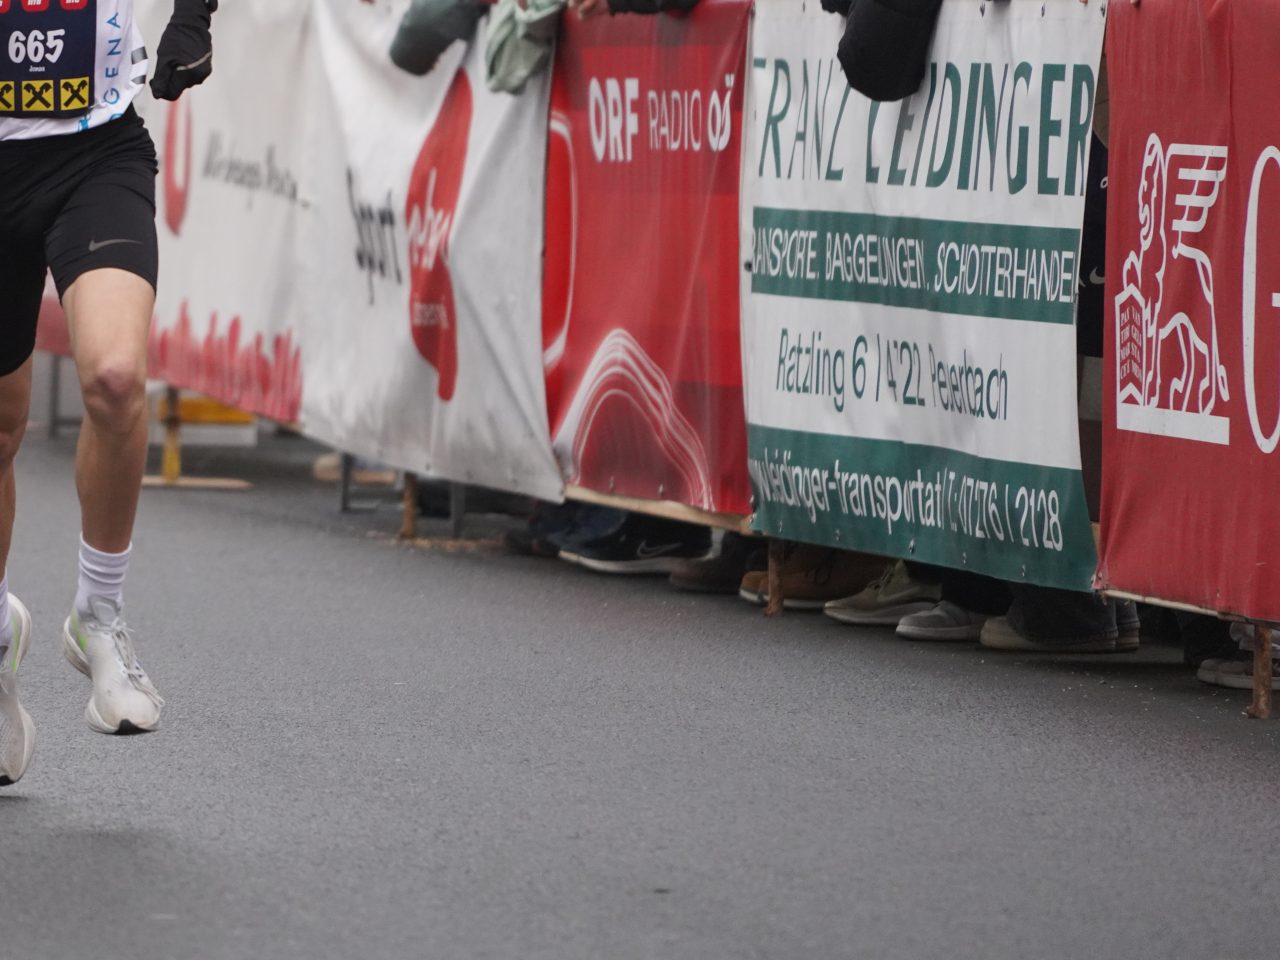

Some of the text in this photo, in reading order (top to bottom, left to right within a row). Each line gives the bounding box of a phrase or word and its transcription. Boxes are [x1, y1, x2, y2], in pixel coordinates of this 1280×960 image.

[8, 29, 65, 64] 665
[589, 76, 639, 163] ORF
[648, 89, 702, 152] RADIO
[753, 58, 1096, 196] RANZ LEIDINGER
[776, 328, 845, 413] Ratzling
[852, 335, 868, 399] 6
[1015, 487, 1063, 552] 2128
